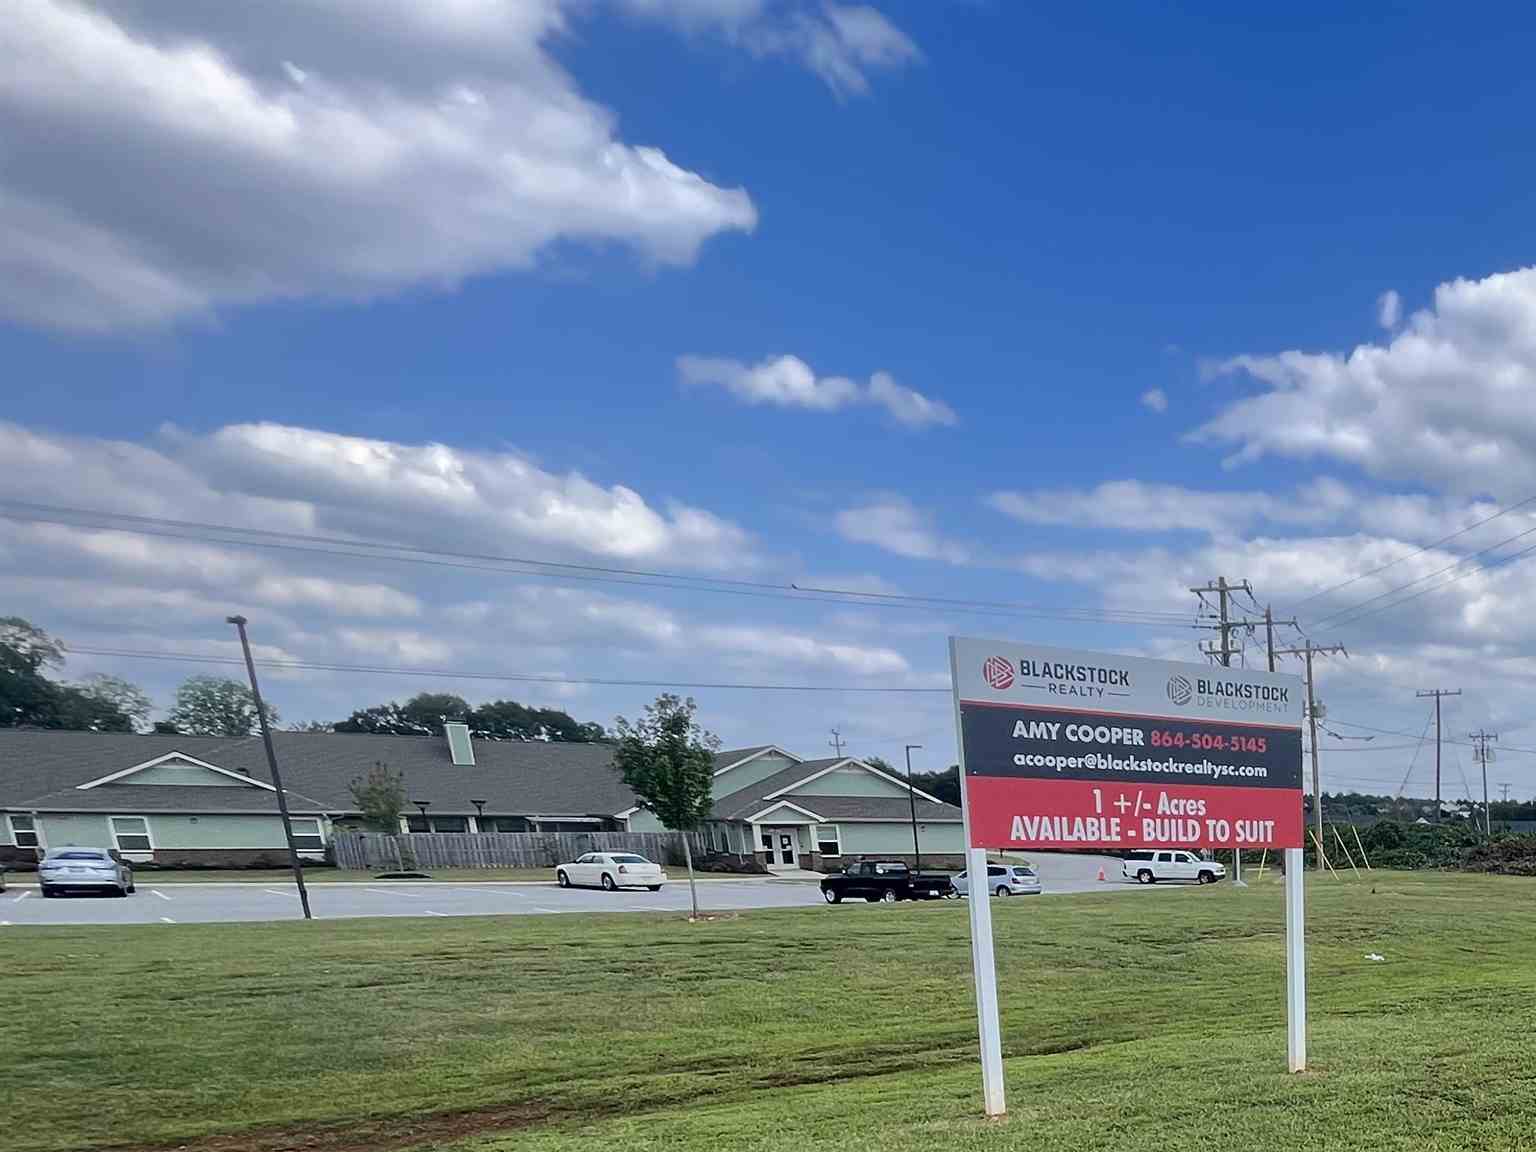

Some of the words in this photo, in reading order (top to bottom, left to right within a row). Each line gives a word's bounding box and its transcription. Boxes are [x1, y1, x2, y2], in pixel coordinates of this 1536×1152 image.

[1021, 659, 1129, 686] BLACKSTOCK
[1049, 684, 1104, 698] REALTY
[1197, 679, 1288, 702] BLACKSTOCK
[1197, 697, 1288, 712] DEVELOPMENT
[1013, 719, 1061, 740] AMY
[1066, 724, 1144, 746] COOPER
[1151, 731, 1266, 753] 864-504-5145
[1013, 753, 1267, 778] acooper@blackstockrealtysc.com
[1092, 789, 1102, 813] 1
[1114, 790, 1151, 817] +/-
[1157, 792, 1206, 815] Acres
[1011, 816, 1121, 842] AVAILABLE
[1143, 819, 1200, 842] BUILD
[1205, 820, 1229, 842] TO
[1236, 821, 1274, 842] SUIT
